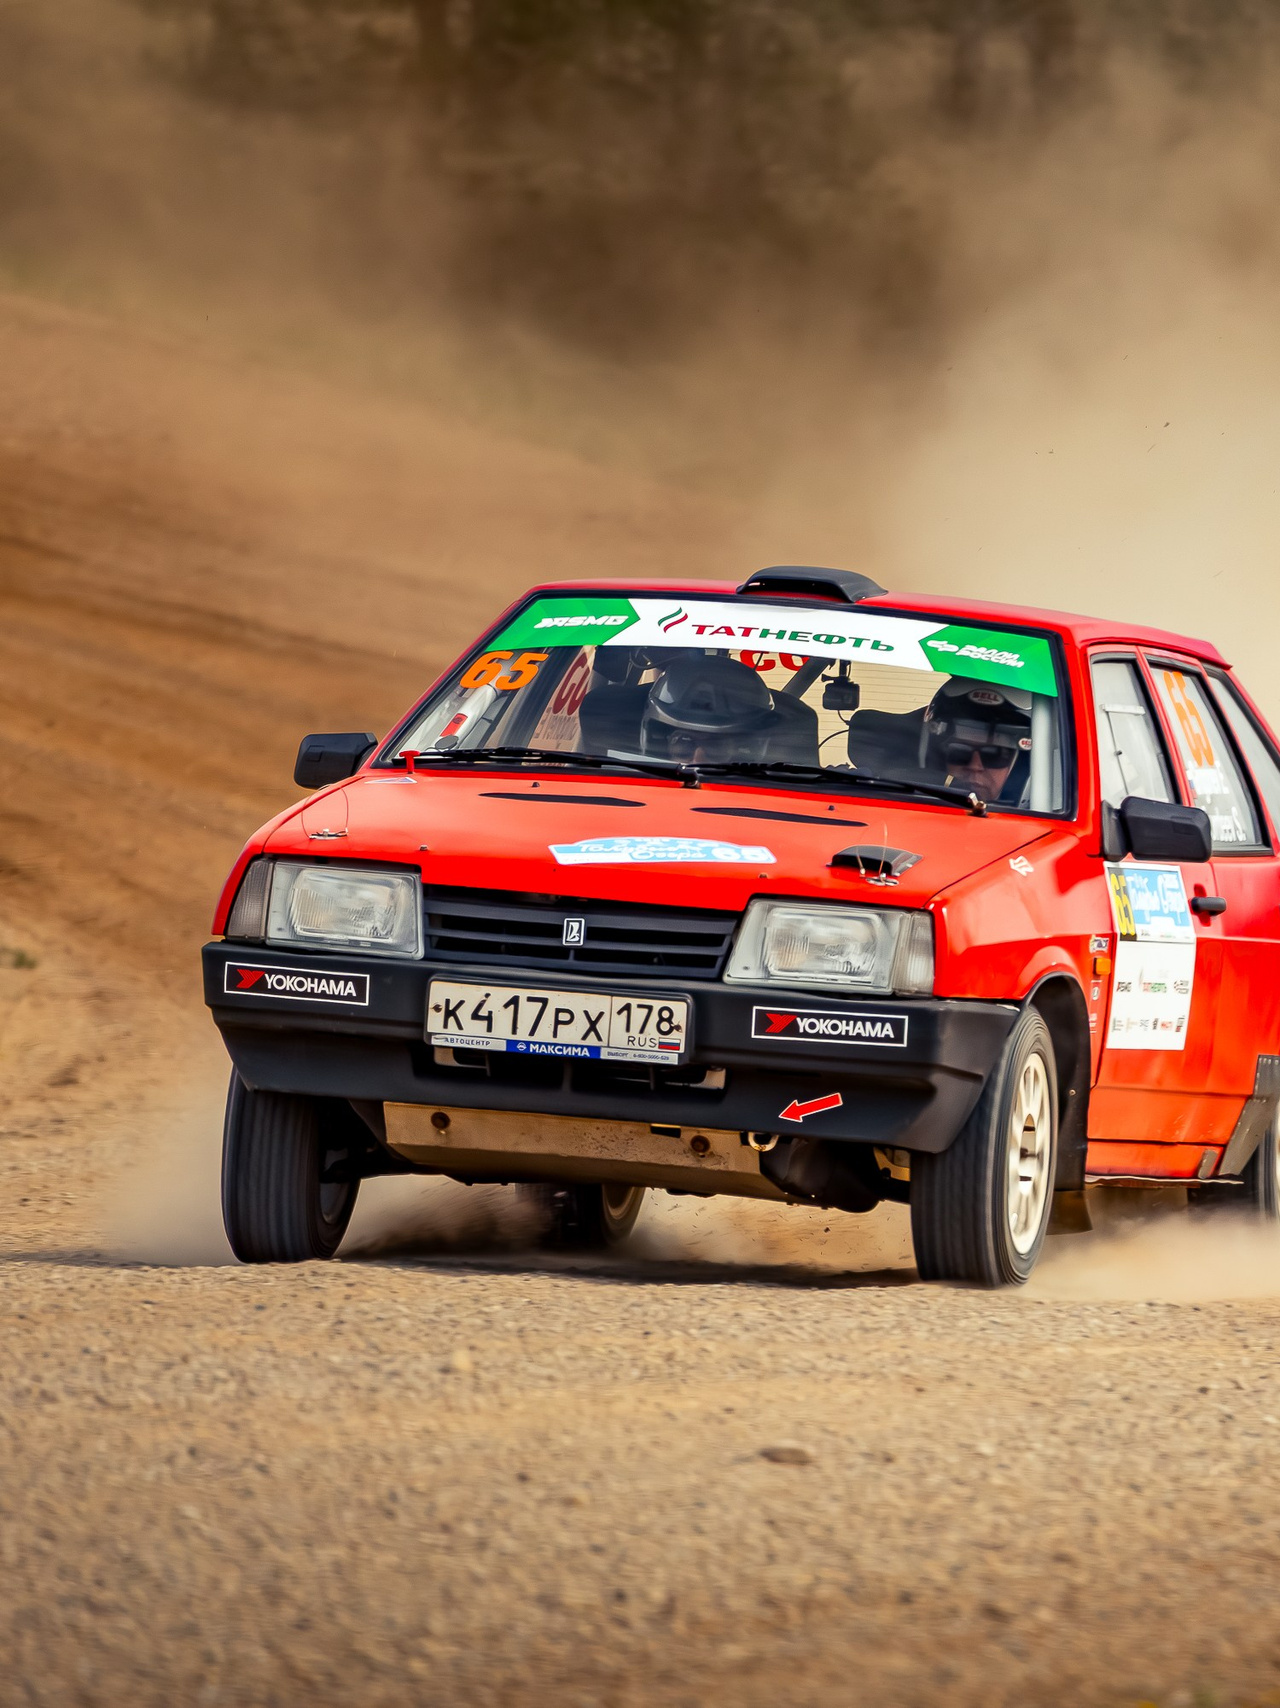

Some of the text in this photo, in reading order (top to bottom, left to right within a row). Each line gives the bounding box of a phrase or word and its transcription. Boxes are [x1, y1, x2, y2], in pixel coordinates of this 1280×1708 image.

[691, 624, 895, 652] ТАТНЕФТЬ
[459, 650, 549, 691] 65
[1163, 671, 1215, 767] 65
[711, 847, 768, 861] 65
[1110, 873, 1136, 935] 65
[264, 973, 357, 997] YOKOHAMA
[617, 1002, 675, 1036] 178
[796, 1017, 895, 1039] YOKOHAMA
[529, 1042, 591, 1057] МАКСИМА
[627, 1036, 657, 1048] RUS
